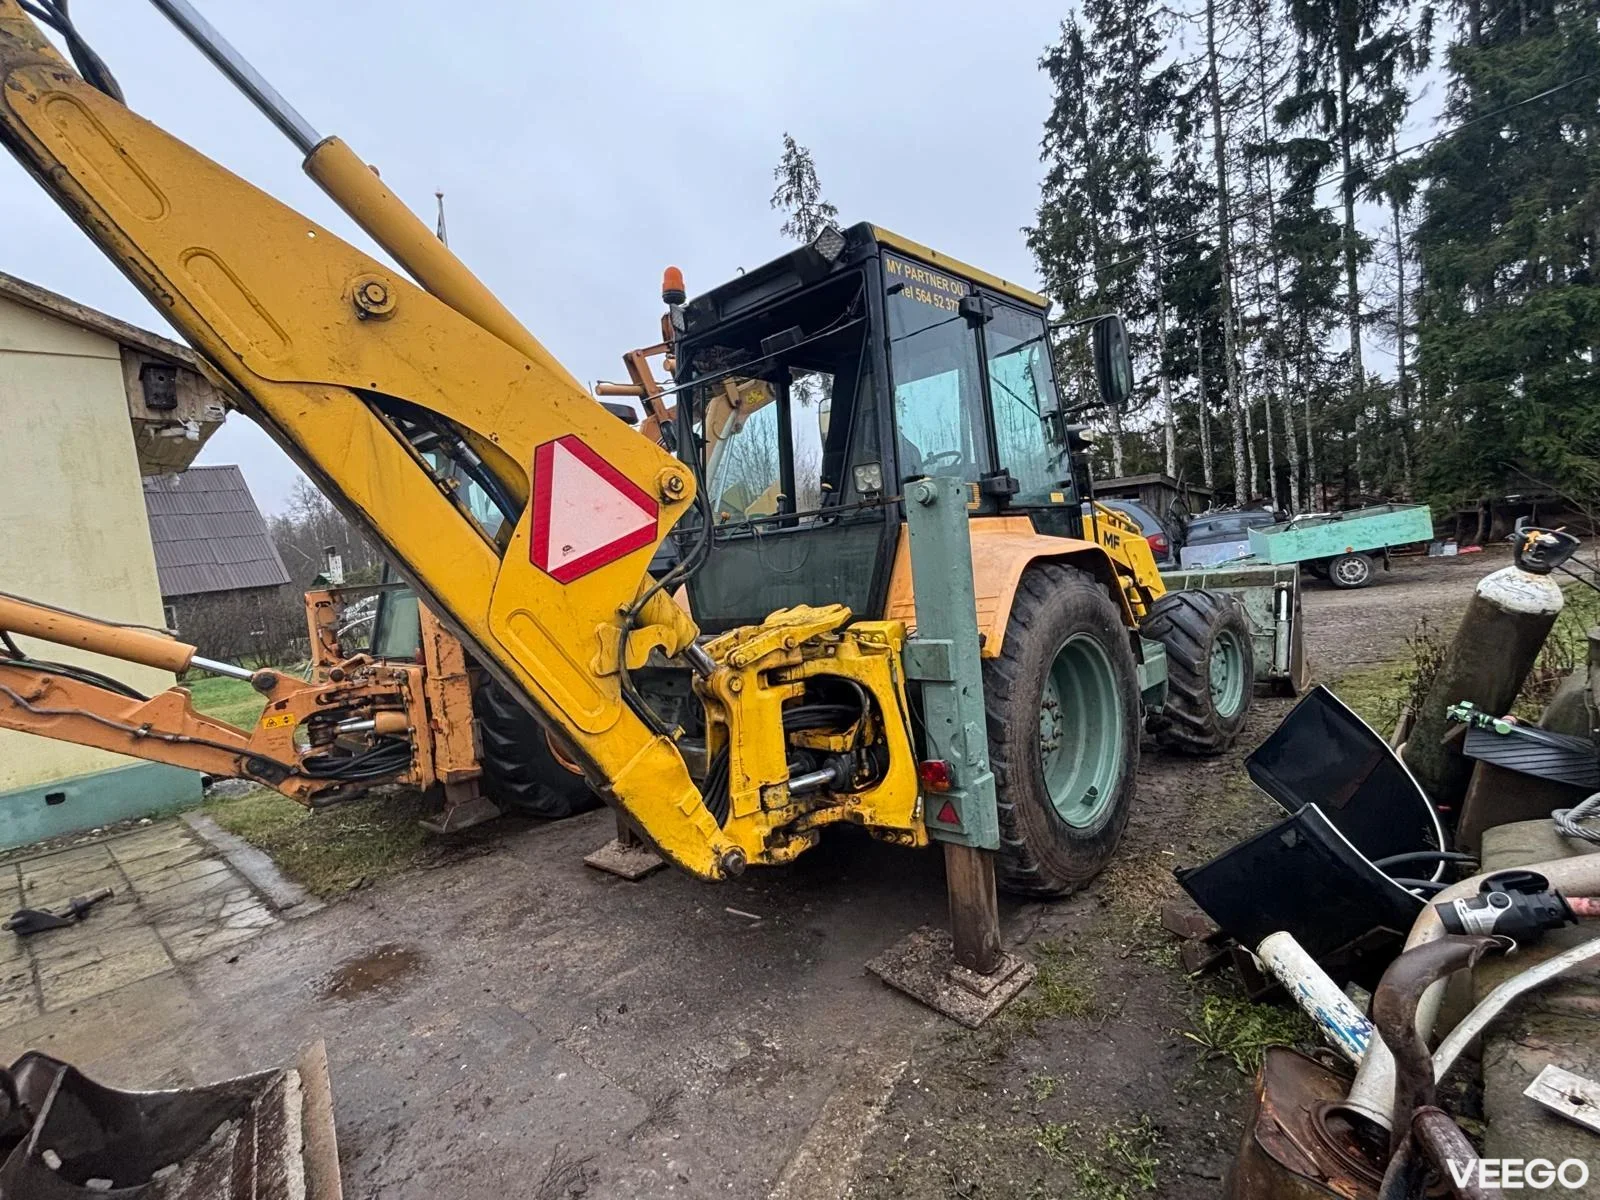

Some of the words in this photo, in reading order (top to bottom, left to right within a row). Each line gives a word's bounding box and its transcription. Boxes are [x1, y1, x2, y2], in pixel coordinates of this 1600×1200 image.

[886, 258, 902, 275] MY
[904, 265, 949, 292] PARTNER
[915, 288, 932, 304] 564
[933, 293, 945, 308] 52
[1103, 531, 1120, 550] MF
